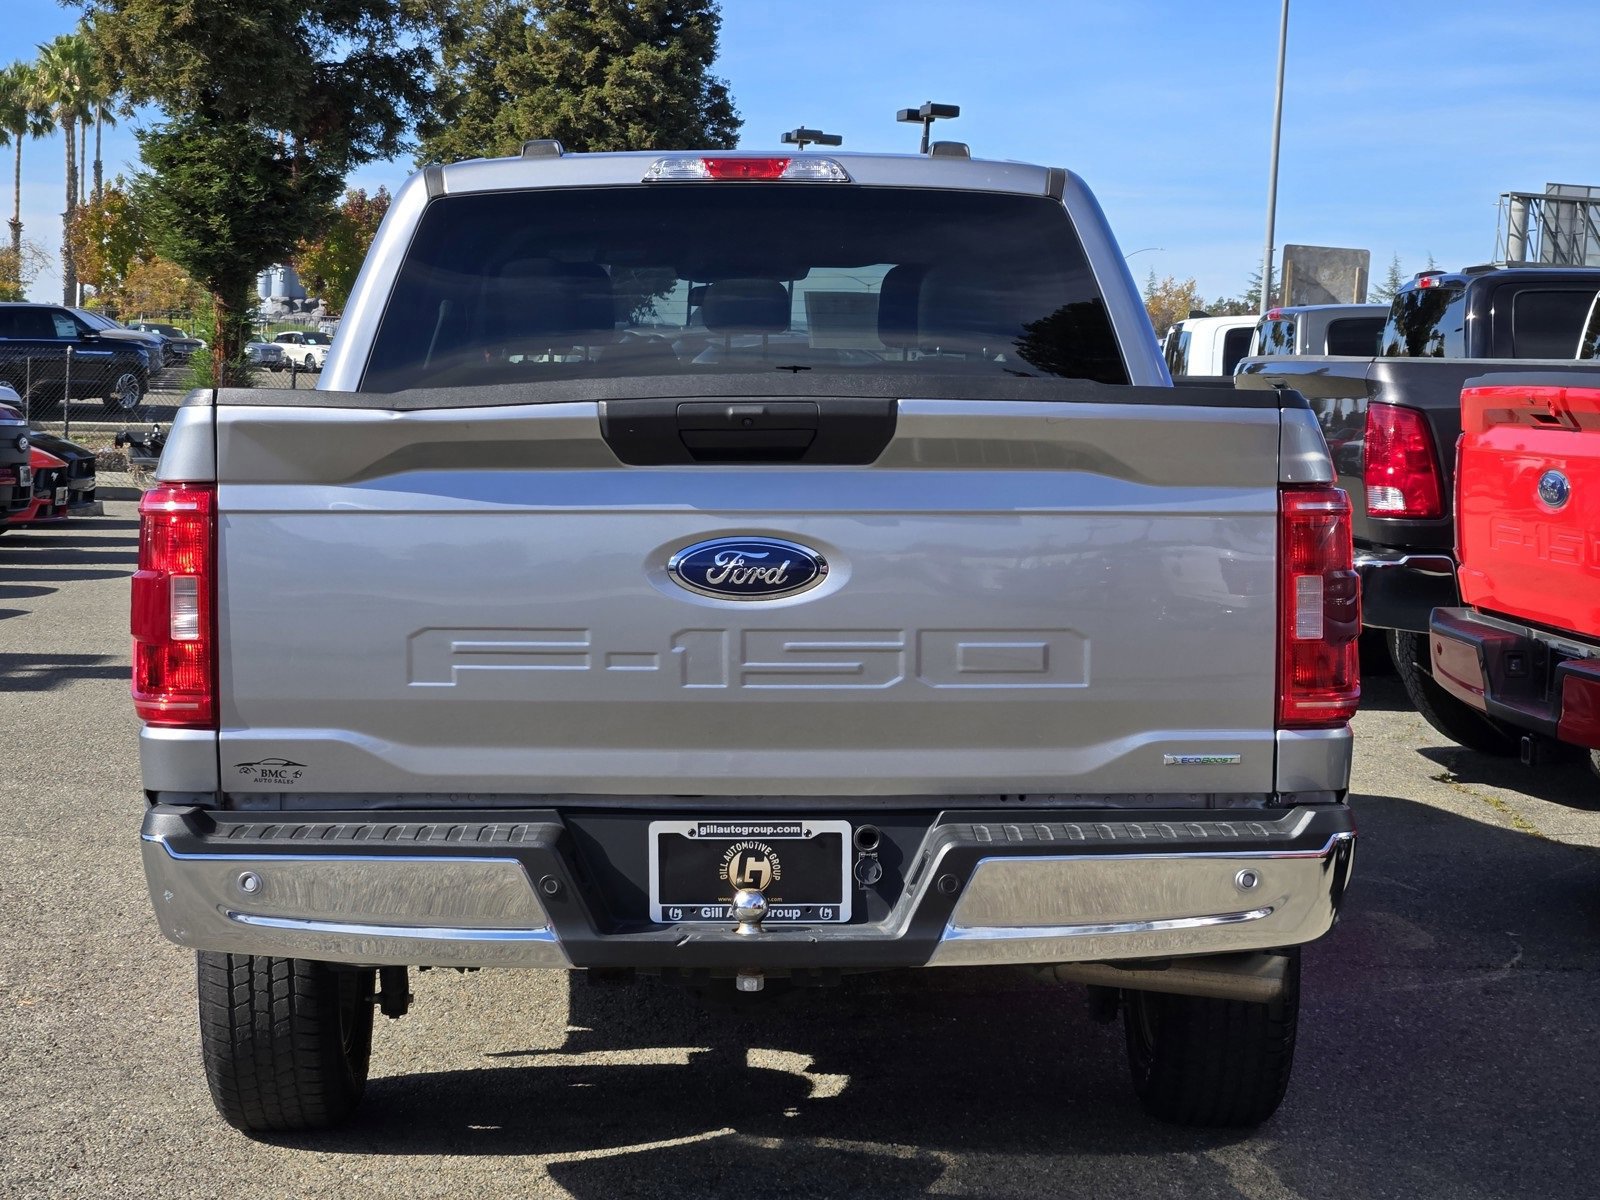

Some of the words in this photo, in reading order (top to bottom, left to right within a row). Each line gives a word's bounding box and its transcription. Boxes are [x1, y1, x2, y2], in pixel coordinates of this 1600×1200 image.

[706, 550, 791, 585] Ford
[407, 627, 1092, 690] F-150
[261, 769, 287, 778] BMC
[700, 824, 801, 836] gillautogroup.com
[723, 841, 773, 862] AUTOMOTIVE
[720, 863, 729, 880] GILL
[769, 853, 782, 881] GROUP
[700, 907, 723, 918] Gill
